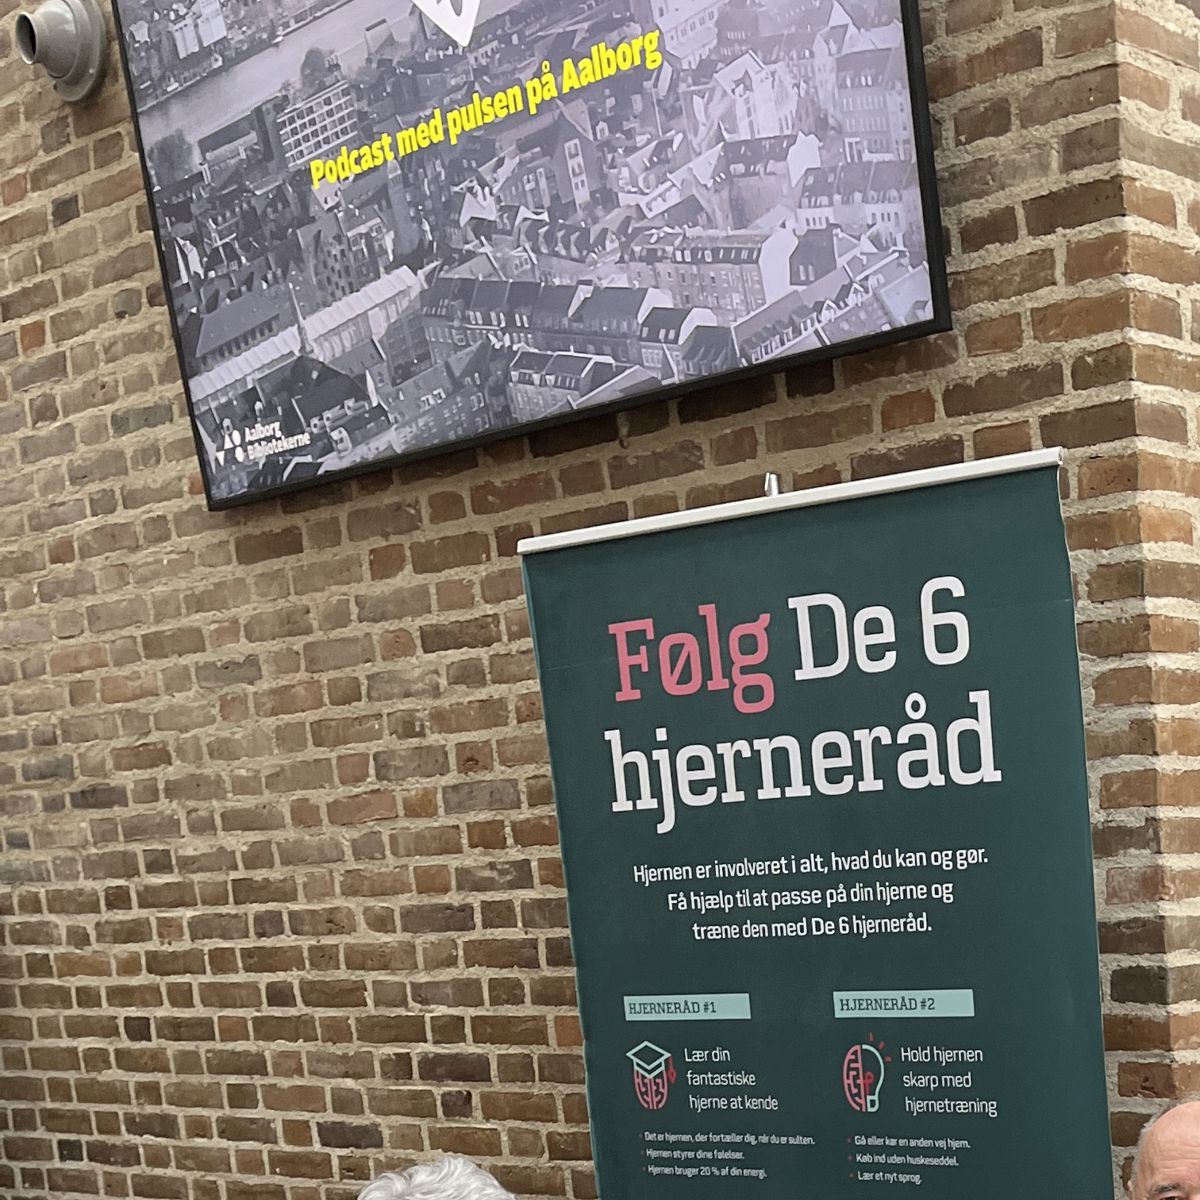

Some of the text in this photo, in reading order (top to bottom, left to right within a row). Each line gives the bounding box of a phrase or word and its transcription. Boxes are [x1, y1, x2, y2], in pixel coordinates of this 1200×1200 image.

[309, 29, 664, 189] Podcast med pulsen på Aalborg
[244, 421, 282, 442] Aalborg
[608, 575, 971, 714] Følg De 6
[603, 689, 1002, 834] hjerneråd
[633, 848, 989, 887] Hjernen er involveret i alt, hvad du kan og gør.
[667, 881, 954, 914] Få hjælp til at passe på din hjerne og
[692, 912, 932, 940] træne den med De 6 hjerneråd.
[628, 999, 717, 1015] HJERNERÅD #1
[839, 996, 936, 1012] HJERNERÅD #2
[683, 1046, 731, 1063] Lær din
[900, 1046, 984, 1067] Hold hjernen
[686, 1070, 757, 1086] fantastiske
[902, 1071, 972, 1091] skarp med
[688, 1094, 779, 1113] hjerne at kende
[904, 1096, 998, 1118] hjernetræning
[644, 1131, 657, 1142] Det
[695, 1132, 708, 1142] der
[770, 1134, 779, 1144] du
[854, 1135, 867, 1146] Gå
[867, 1136, 885, 1146] eller
[898, 1138, 908, 1147] en
[909, 1137, 934, 1148] anden
[934, 1139, 947, 1151] vej
[646, 1148, 673, 1160] Hjernen
[673, 1149, 695, 1161] styrer
[696, 1149, 713, 1159] dine
[873, 1153, 886, 1164] ind
[886, 1154, 906, 1164] uden
[647, 1164, 674, 1177] Hjernen
[674, 1165, 699, 1178] bruger
[700, 1166, 711, 1176] 20
[711, 1166, 720, 1176] %
[720, 1166, 729, 1176] af
[730, 1166, 742, 1176] din
[857, 1171, 874, 1181] Lær
[874, 1171, 884, 1181] et
[884, 1171, 898, 1184] nyt
